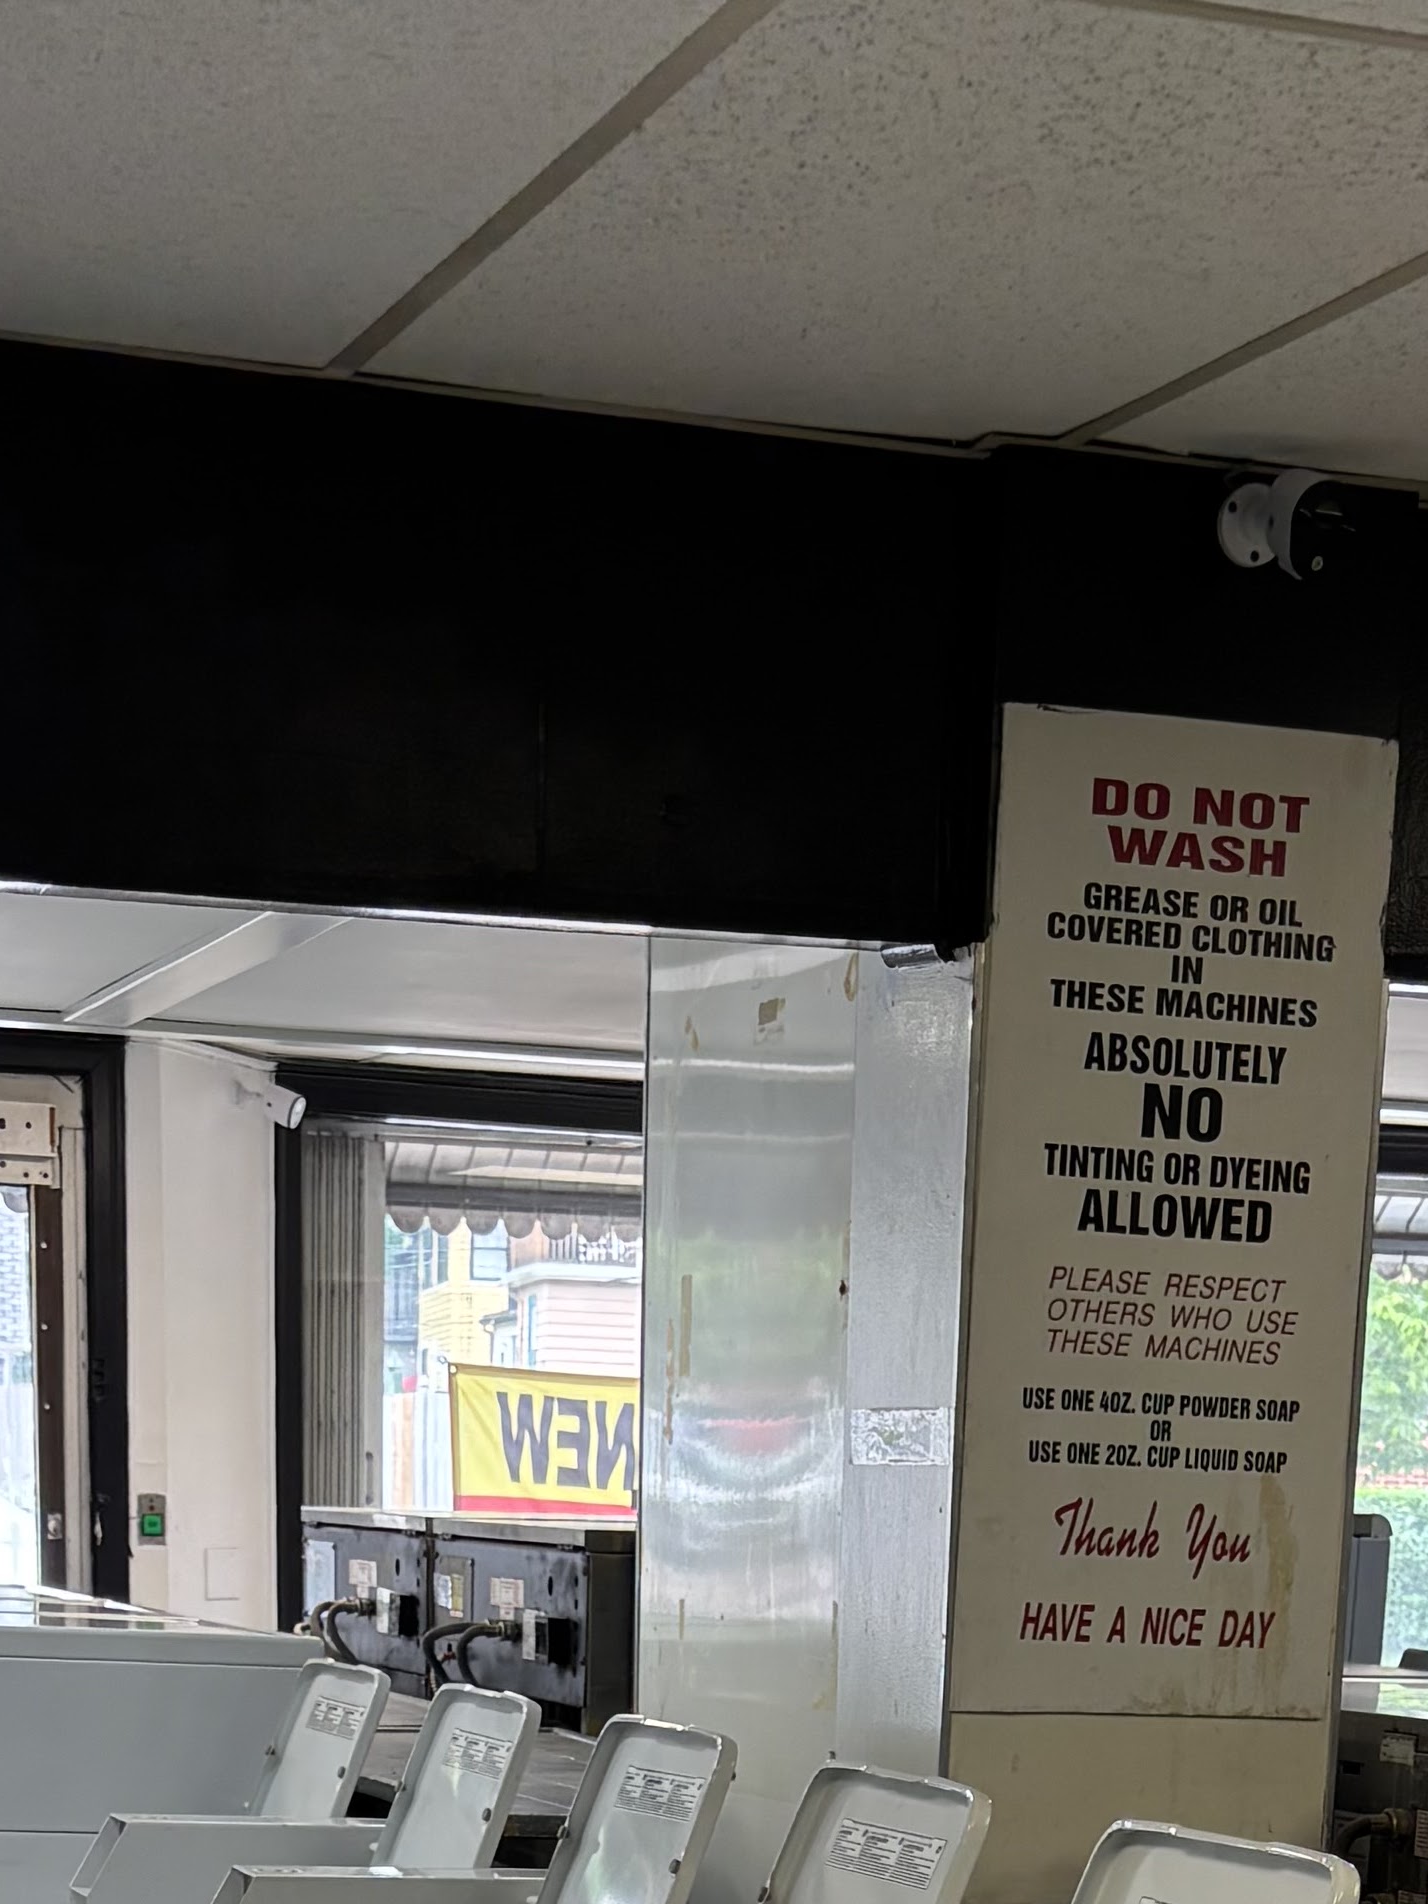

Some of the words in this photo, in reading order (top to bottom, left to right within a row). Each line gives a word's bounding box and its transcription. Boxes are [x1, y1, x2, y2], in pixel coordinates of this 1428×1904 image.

[1092, 778, 1170, 820] DO
[1193, 787, 1310, 833] NOT
[1108, 825, 1286, 877] WASH
[1084, 882, 1199, 918] GREASE
[1210, 895, 1249, 923] OR
[1259, 899, 1302, 927] OIL
[1048, 912, 1181, 949] COVERED
[1192, 925, 1336, 962] CLOTHING
[1171, 955, 1203, 984] IN
[1051, 979, 1145, 1014] THESE
[1156, 988, 1317, 1027] MACHINES
[1084, 1032, 1287, 1084] ABSOLUTELY
[1141, 1083, 1223, 1142] NO
[1044, 1143, 1154, 1183] TINTING
[1164, 1153, 1200, 1185] OR
[1210, 1156, 1310, 1194] DYEING
[1078, 1189, 1272, 1243] ALLOWED
[1049, 1266, 1151, 1295] PLEASE
[1164, 1273, 1286, 1303] RESPECT
[1048, 1298, 1155, 1327] OTHERS
[1172, 1305, 1231, 1331] WHO
[1247, 1309, 1299, 1335] USE
[1048, 1329, 1132, 1356] THESE
[1145, 1335, 1280, 1365] MACHINES
[1023, 1387, 1055, 1409] USE
[1062, 1389, 1095, 1412] ONE
[1100, 1391, 1135, 1413] 4OZ.
[1142, 1393, 1174, 1415] CUP
[1179, 1395, 1251, 1419] POWDER
[1256, 1399, 1300, 1422] SOAP
[1150, 1420, 1171, 1442] OR
[1029, 1440, 1061, 1463] USE
[1067, 1442, 1100, 1465] ONE
[1105, 1444, 1141, 1467] 2OZ.
[1147, 1446, 1180, 1468] CUP
[1185, 1448, 1238, 1472] LIQUID
[1244, 1451, 1287, 1473] SOAP
[1055, 1497, 1159, 1558] Thank
[1186, 1503, 1250, 1579] You
[1020, 1602, 1095, 1642] HAVE
[1107, 1606, 1125, 1643] A
[1141, 1607, 1206, 1646] NICE
[1218, 1610, 1276, 1648] DAY
